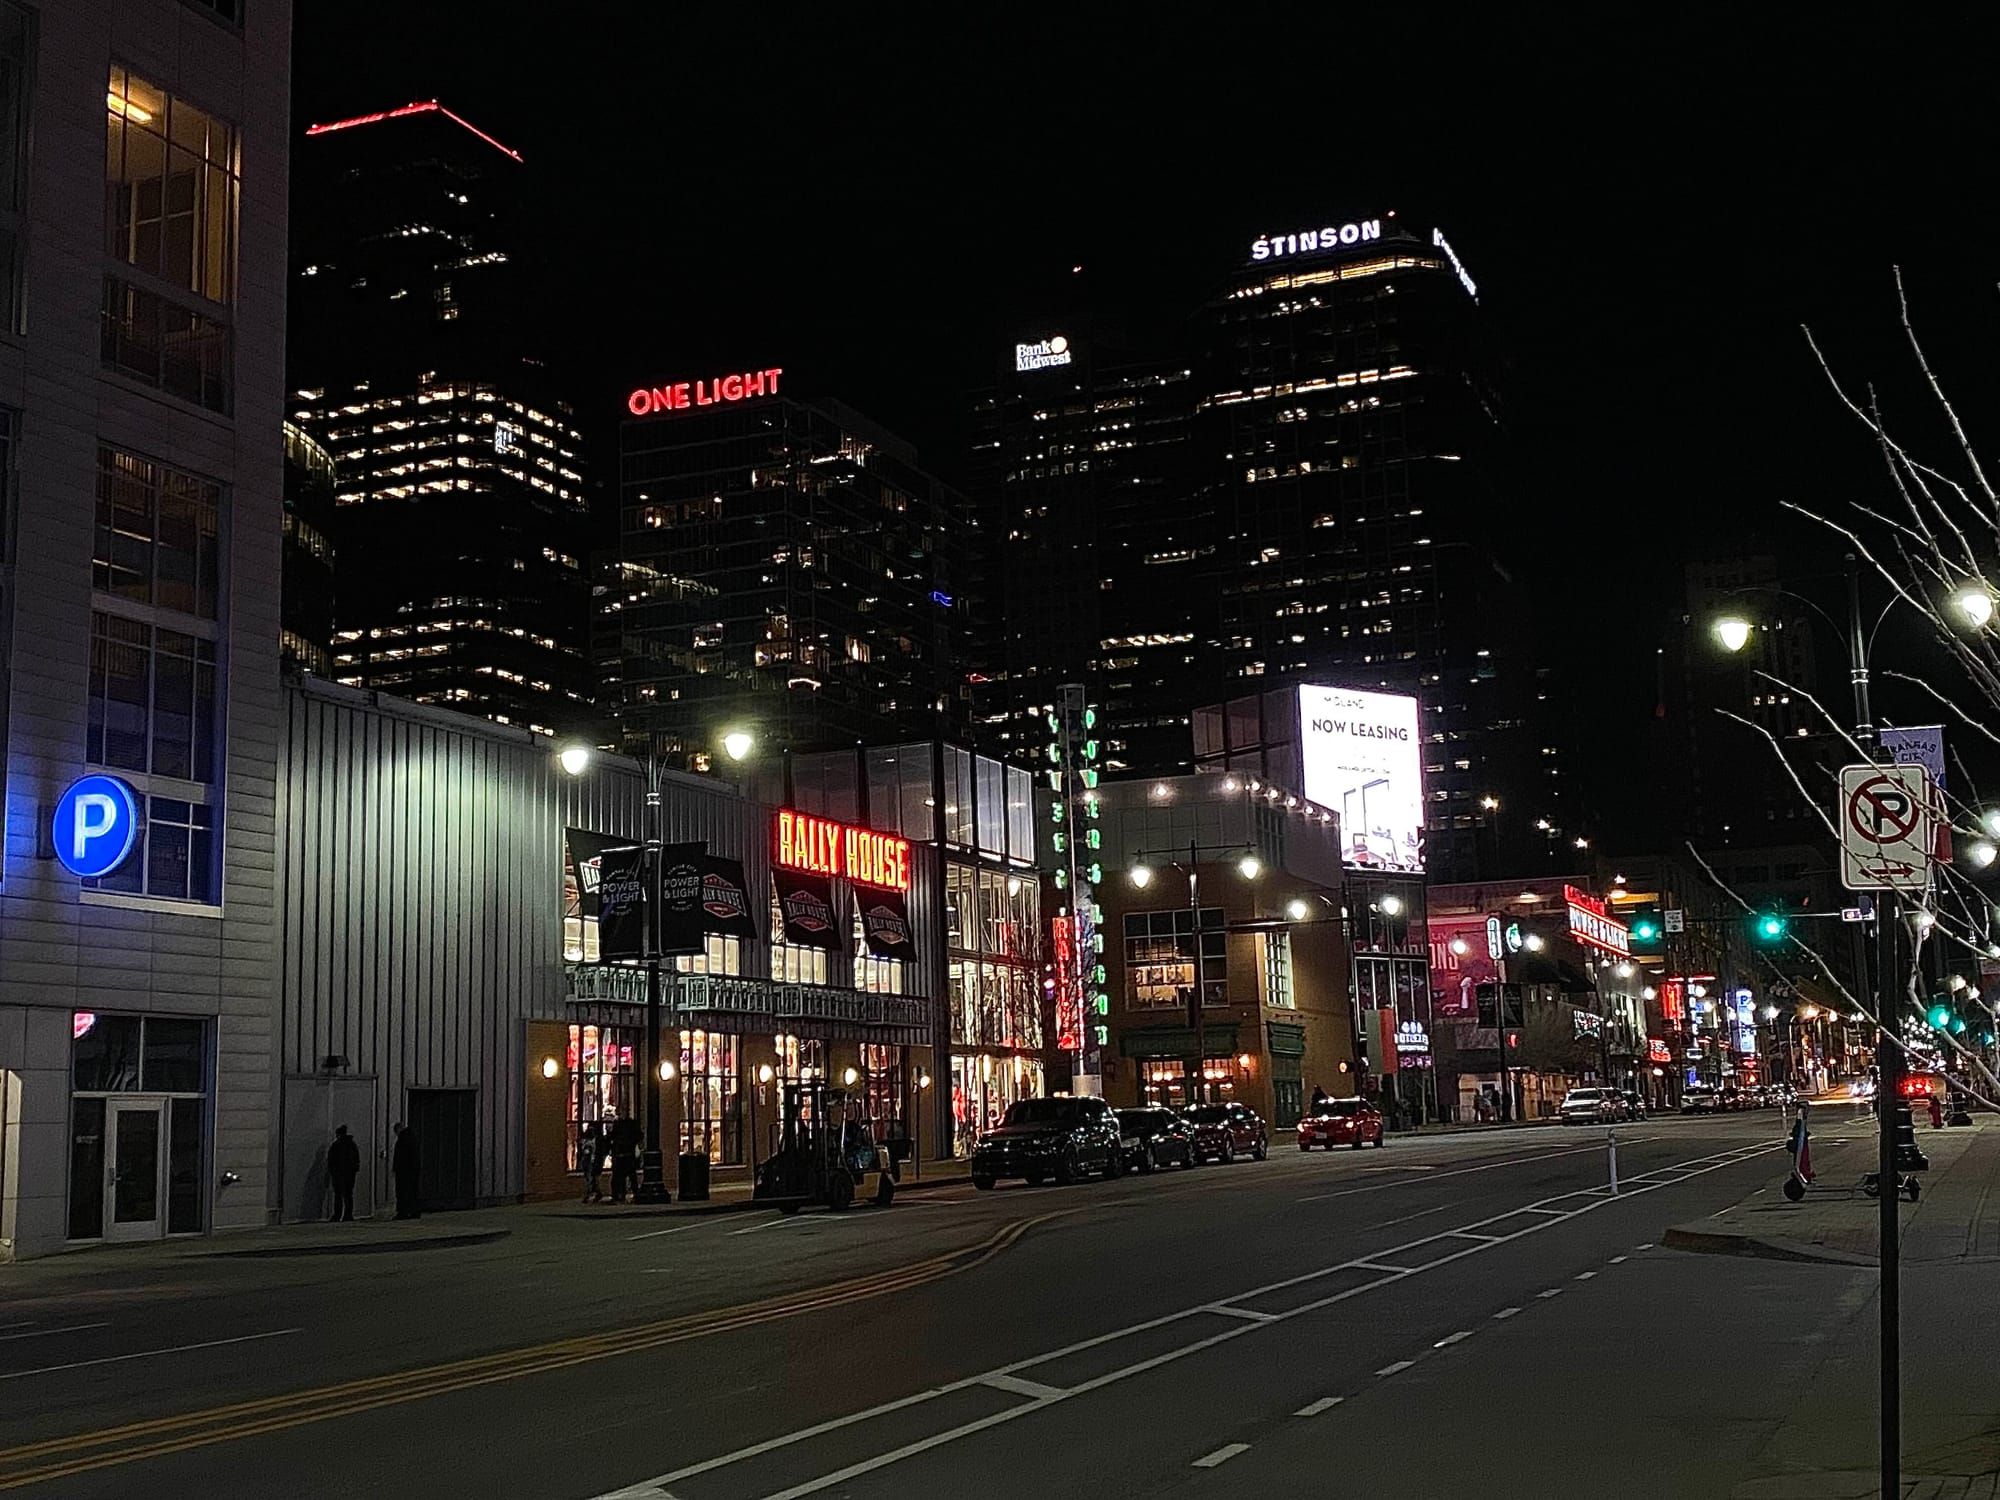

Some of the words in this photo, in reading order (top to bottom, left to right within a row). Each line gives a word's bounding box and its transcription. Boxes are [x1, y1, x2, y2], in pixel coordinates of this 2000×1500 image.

[1252, 220, 1380, 260] STINSON
[1016, 340, 1051, 357] Bank
[1016, 350, 1071, 371] Midwest
[628, 383, 691, 416] ONE
[696, 368, 783, 406] LIGHT
[1312, 719, 1346, 733] NOW
[1351, 722, 1408, 741] LEASING
[1890, 740, 1937, 754] KANSAS
[73, 794, 117, 859] P
[779, 811, 840, 875] RALLY
[845, 827, 908, 890] HOUSE
[602, 881, 640, 893] POWER
[664, 876, 699, 888] POWER
[602, 894, 611, 903] &
[611, 891, 640, 903] LIGHT
[664, 890, 671, 899] &
[672, 887, 699, 899] LIGHT
